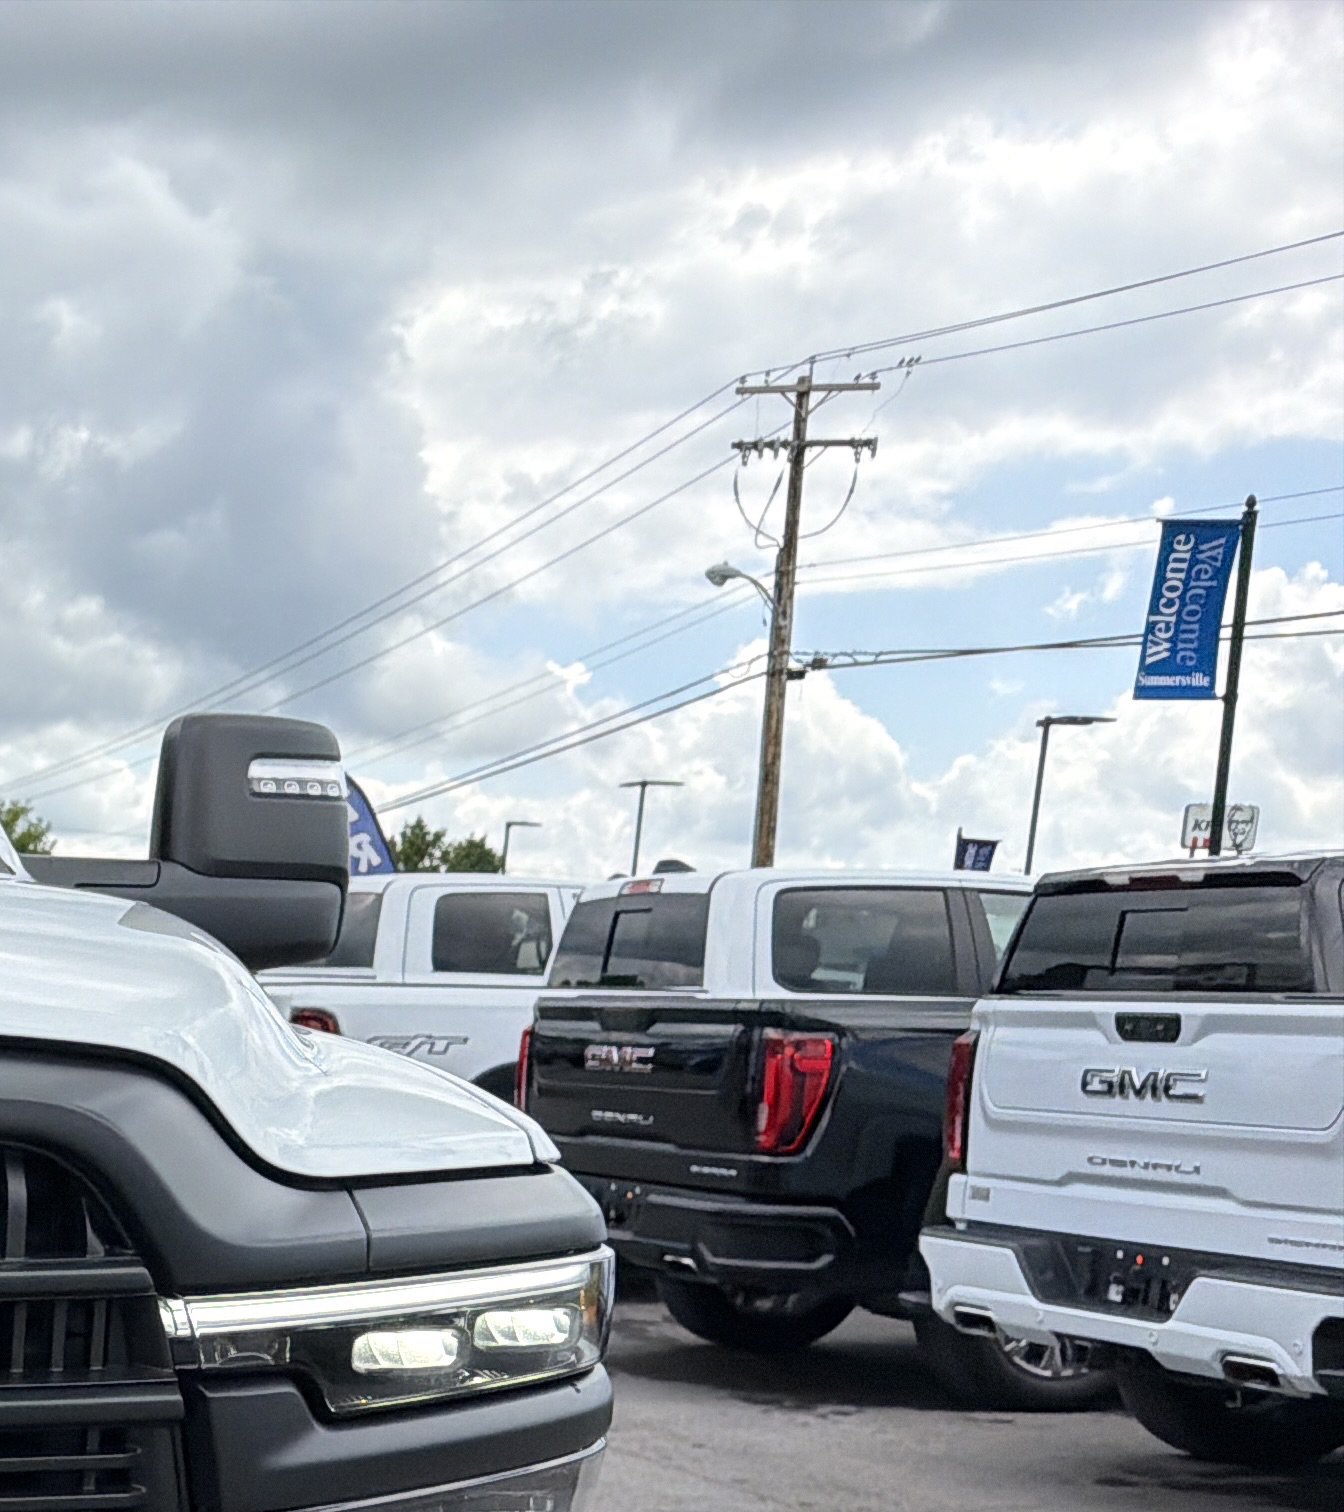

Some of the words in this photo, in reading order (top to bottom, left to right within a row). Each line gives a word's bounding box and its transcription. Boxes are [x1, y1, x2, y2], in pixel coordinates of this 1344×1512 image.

[1145, 533, 1195, 666] Welcome
[1176, 536, 1228, 667] Welcome
[1138, 672, 1210, 687] Summersville
[584, 1044, 655, 1073] GMC
[1080, 1067, 1209, 1104] GMC
[1086, 1155, 1201, 1175] DENALI
